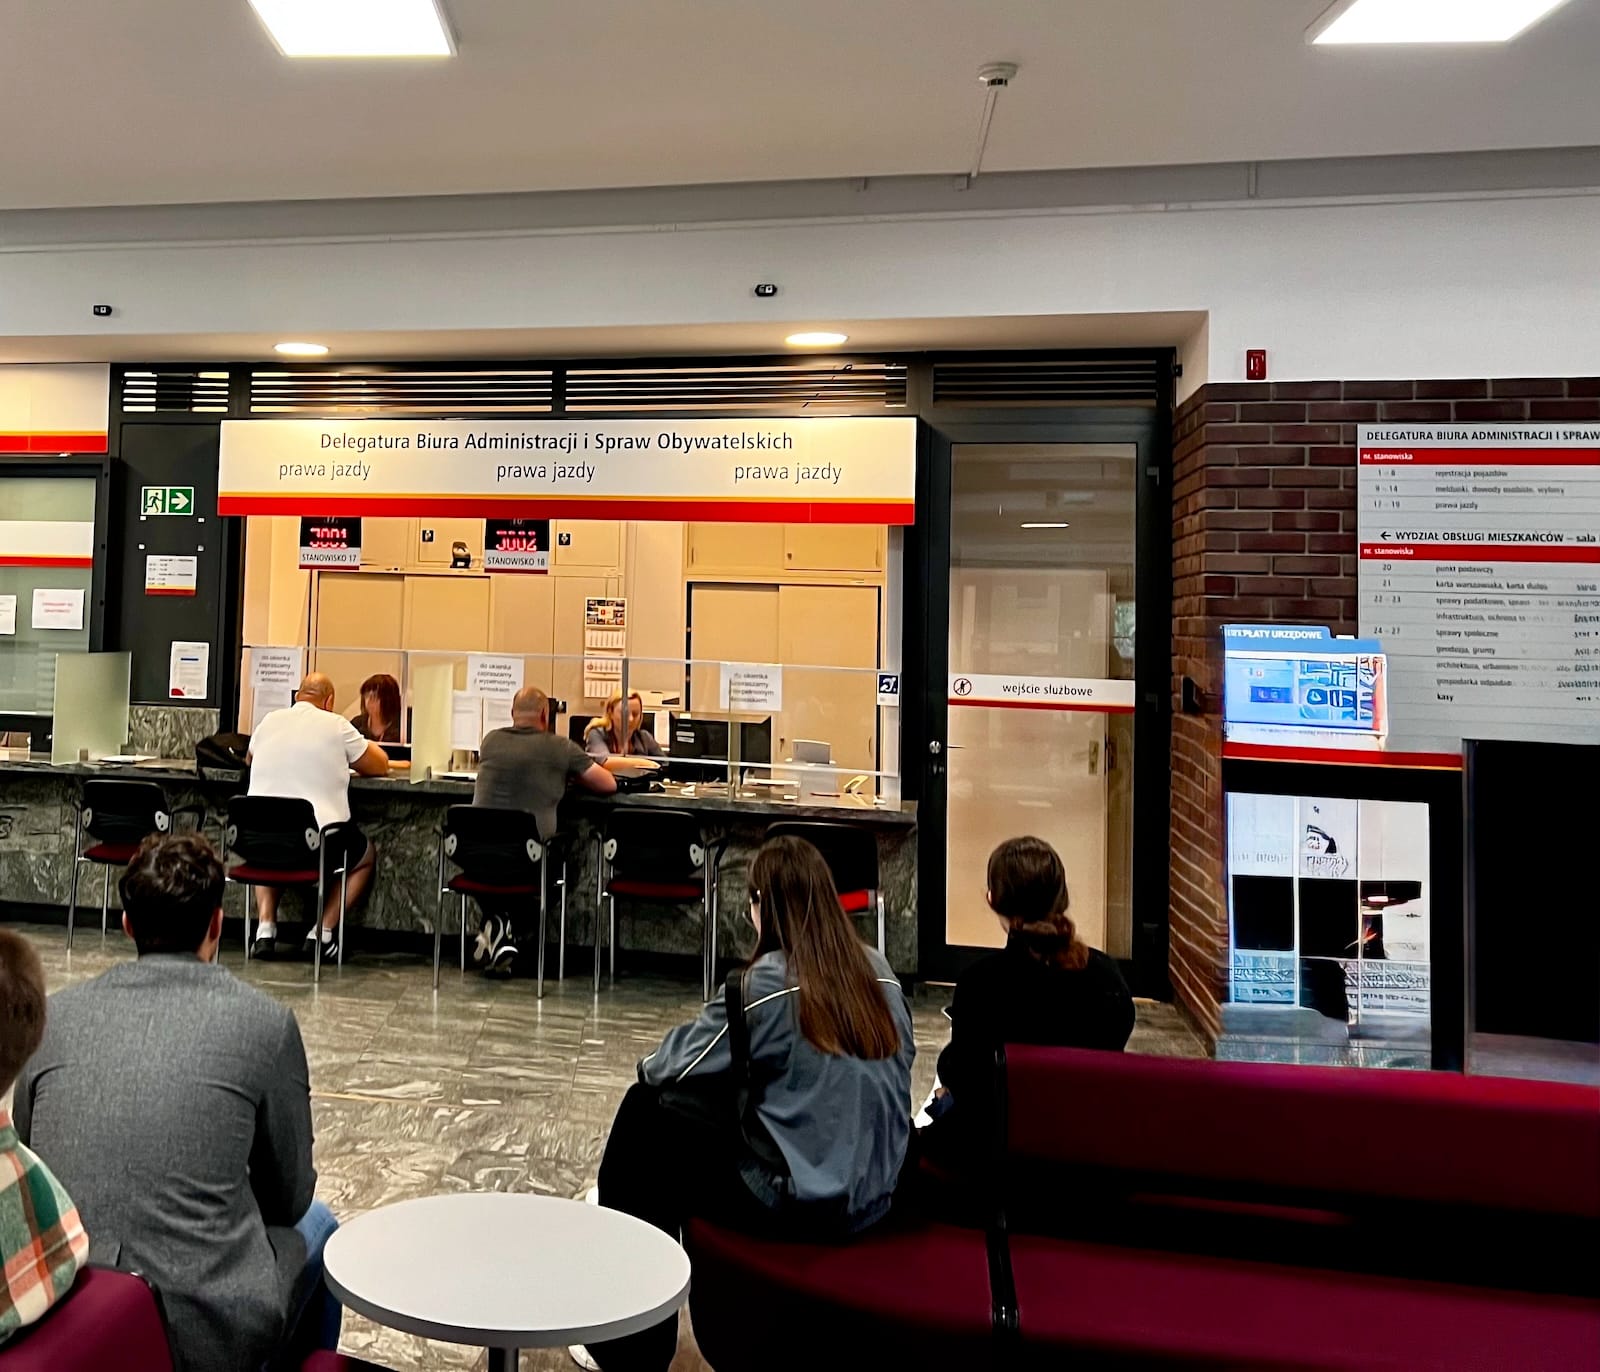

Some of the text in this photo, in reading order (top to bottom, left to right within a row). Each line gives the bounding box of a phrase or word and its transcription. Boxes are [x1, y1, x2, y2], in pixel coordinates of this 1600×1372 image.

[1366, 430, 1433, 441] DELEGATURA
[1436, 430, 1468, 441] BIURA
[1471, 431, 1553, 441] ADMINISTRACJI
[1562, 431, 1600, 441] SPRAW
[320, 431, 793, 454] Delegatura Biura Administracji i Spraw Obywatelskich
[1374, 452, 1414, 461] stanowiska
[279, 459, 371, 481] prawa jazdy
[496, 461, 596, 483] prawa jazdy
[734, 462, 843, 485] prawa jazdy
[1395, 531, 1440, 541] WYDZIAŁ
[1442, 532, 1485, 542] OBSŁUGI
[1488, 529, 1564, 543] MIESZKAŃCÓW
[1576, 534, 1596, 543] sala
[1374, 547, 1414, 556] stanowiska
[302, 553, 357, 563] STANOWISKO 17
[487, 556, 546, 567] STANOWISKO 18
[1382, 563, 1392, 571] 20
[1436, 565, 1493, 575] punkt podawczy
[1436, 580, 1454, 589] karta
[1271, 630, 1323, 641] URZĘDOWE
[1002, 682, 1093, 697] wejście służbowe
[1437, 693, 1454, 703] kasy
